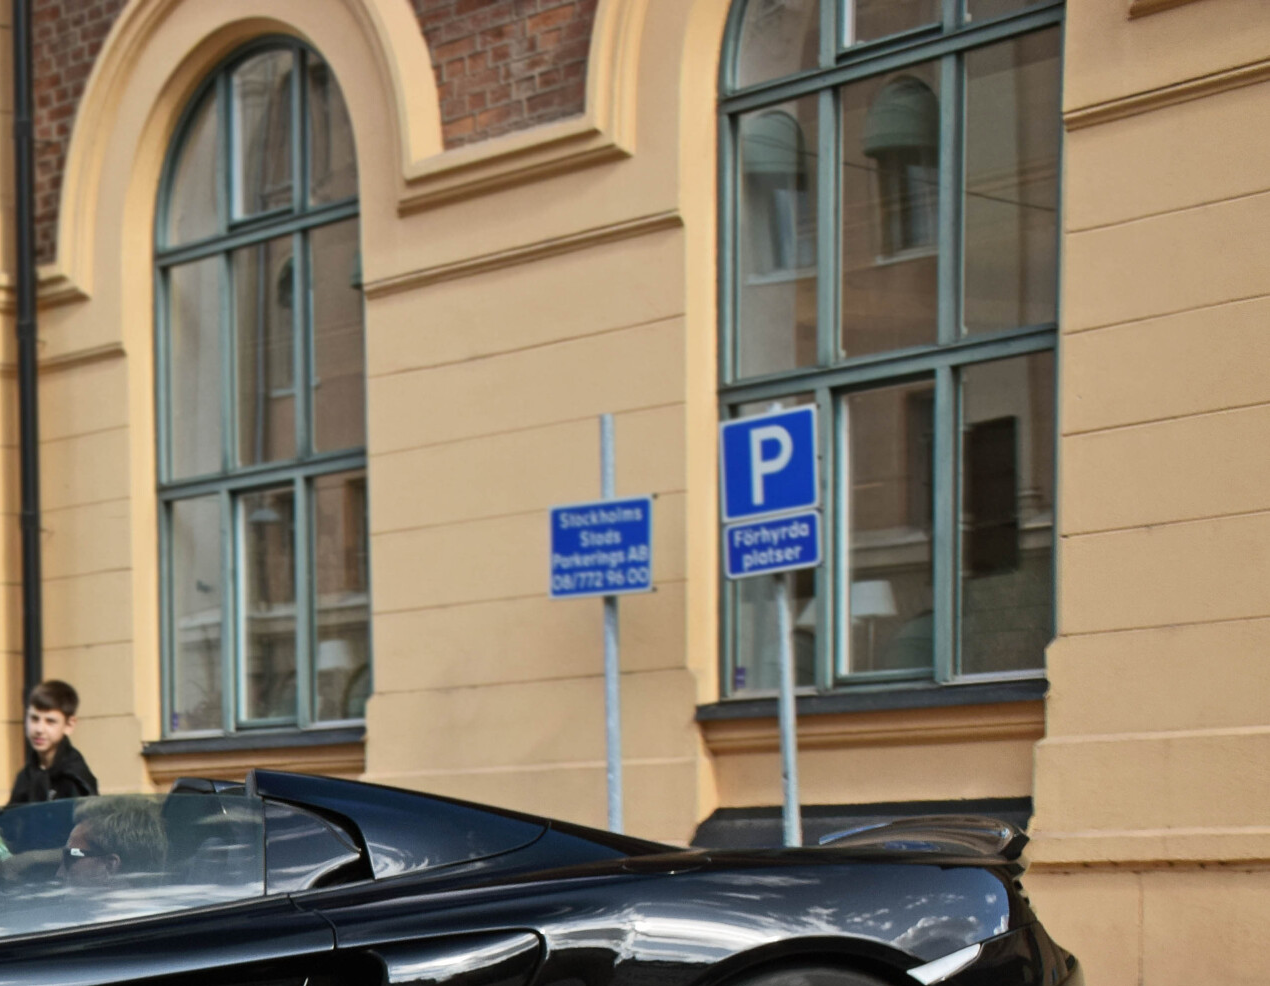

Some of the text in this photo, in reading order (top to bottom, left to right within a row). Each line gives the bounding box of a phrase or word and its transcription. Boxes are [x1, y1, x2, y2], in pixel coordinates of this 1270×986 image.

[750, 425, 794, 506] P
[559, 508, 643, 529] Stockholms
[579, 529, 621, 548] Stads
[734, 521, 809, 547] Förhyrda
[552, 544, 649, 569] Parkerings AB
[742, 546, 802, 571] platser
[552, 566, 649, 591] 08/772 96 00
